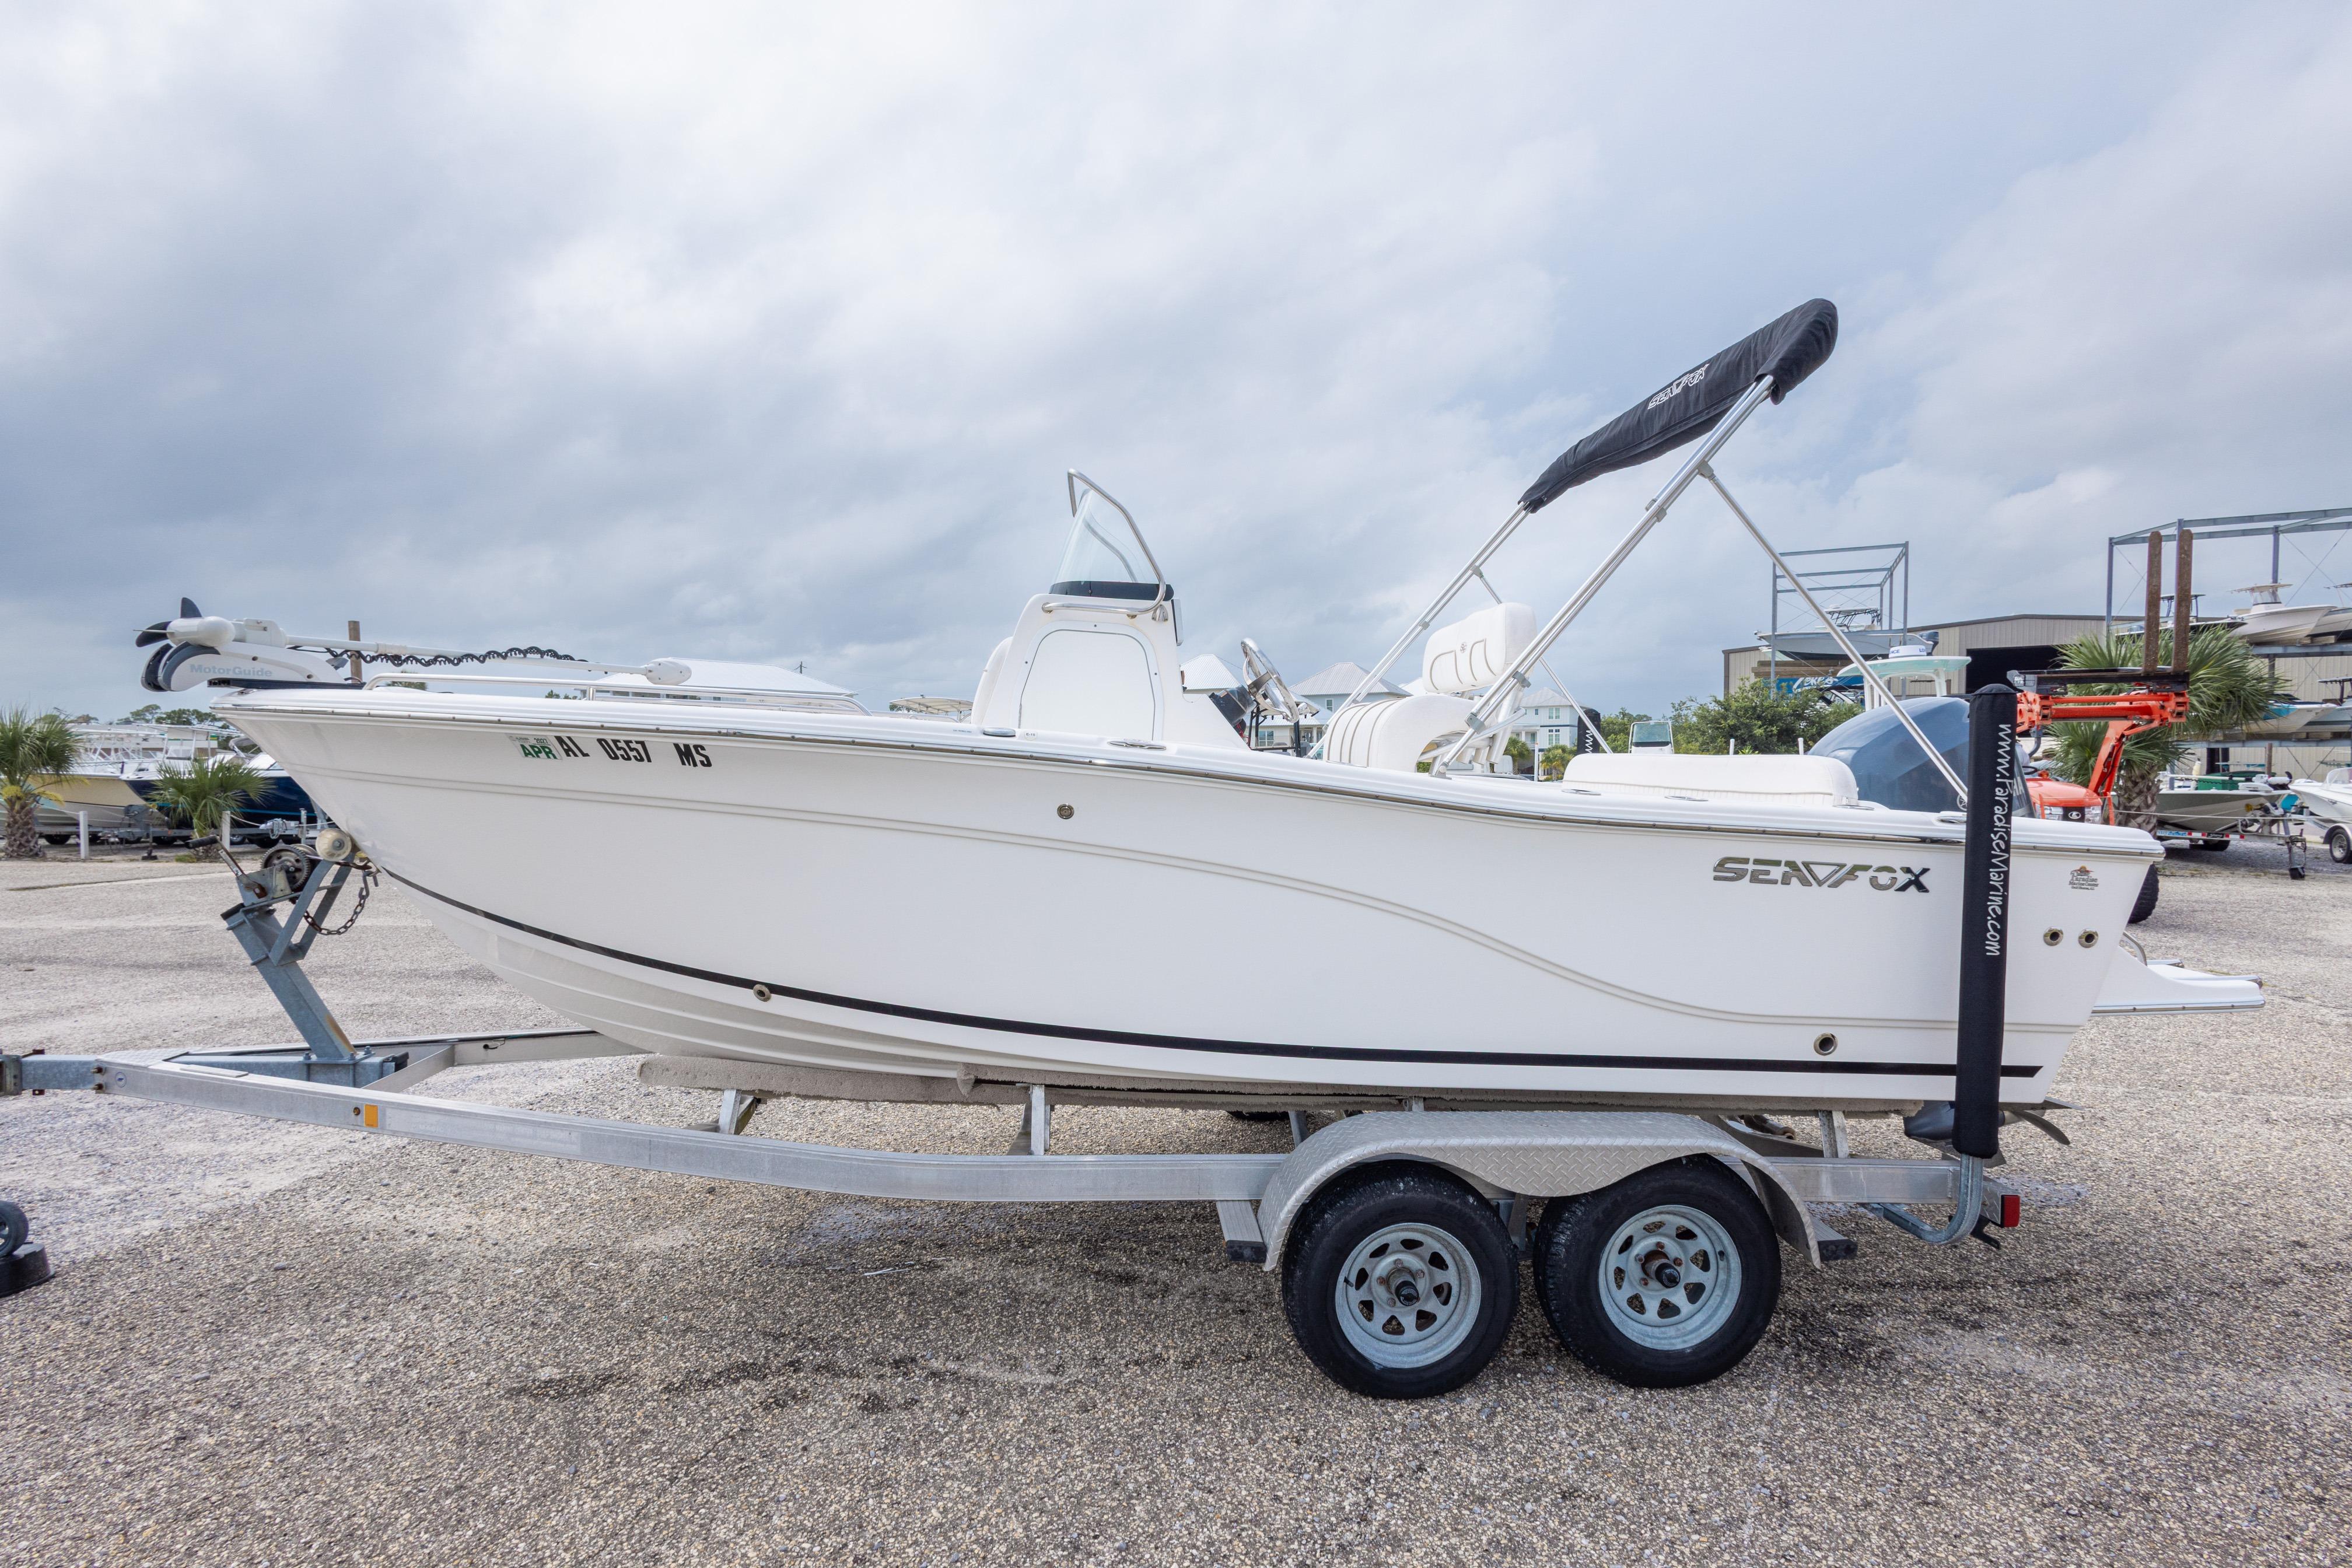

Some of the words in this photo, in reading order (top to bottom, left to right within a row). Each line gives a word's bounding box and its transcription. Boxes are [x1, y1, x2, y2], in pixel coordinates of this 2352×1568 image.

[190, 664, 272, 677] MotorGuide
[520, 744, 558, 760] APR
[554, 736, 590, 757] AL
[596, 738, 652, 762] 0557
[673, 743, 712, 767] MS
[1986, 723, 2014, 956] www.ParadiseMarine.com
[2070, 870, 2098, 883] Paradise
